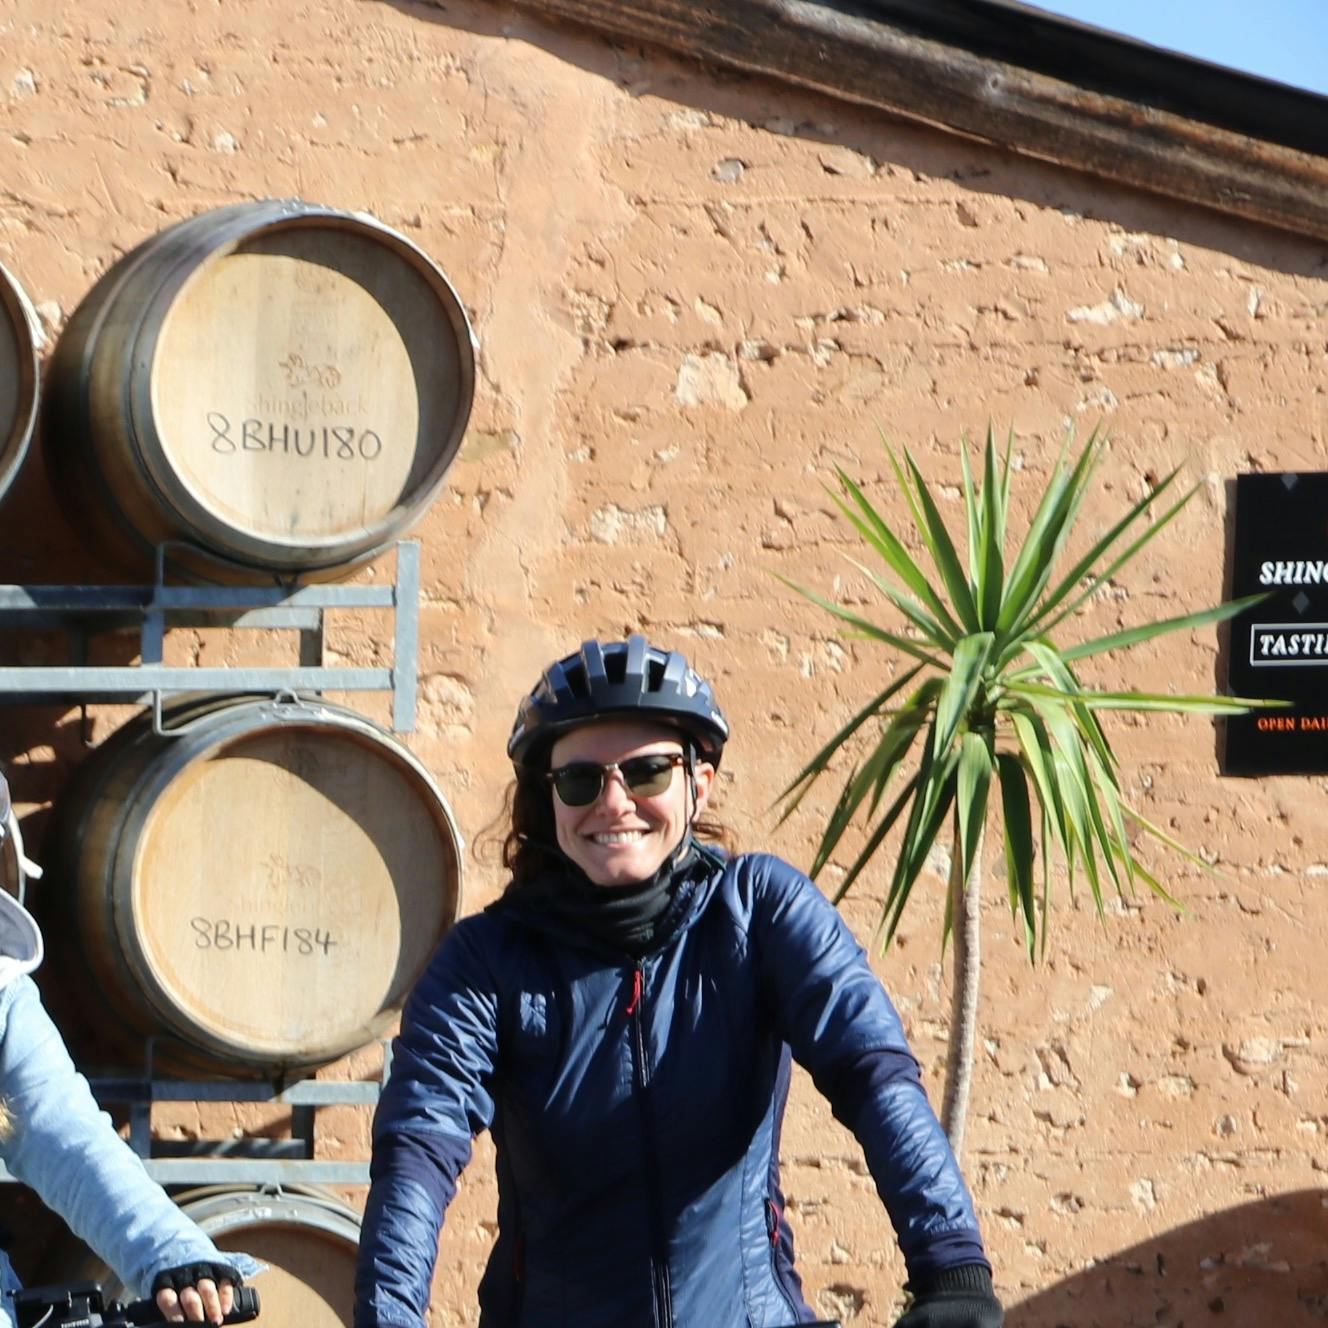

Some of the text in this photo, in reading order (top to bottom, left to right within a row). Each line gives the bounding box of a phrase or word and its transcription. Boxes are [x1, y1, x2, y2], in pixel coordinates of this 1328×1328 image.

[206, 411, 382, 460] 8BHU180
[1259, 633, 1328, 656] TASTI
[1257, 716, 1295, 732] OPEN
[191, 916, 337, 955] 8BHF184
